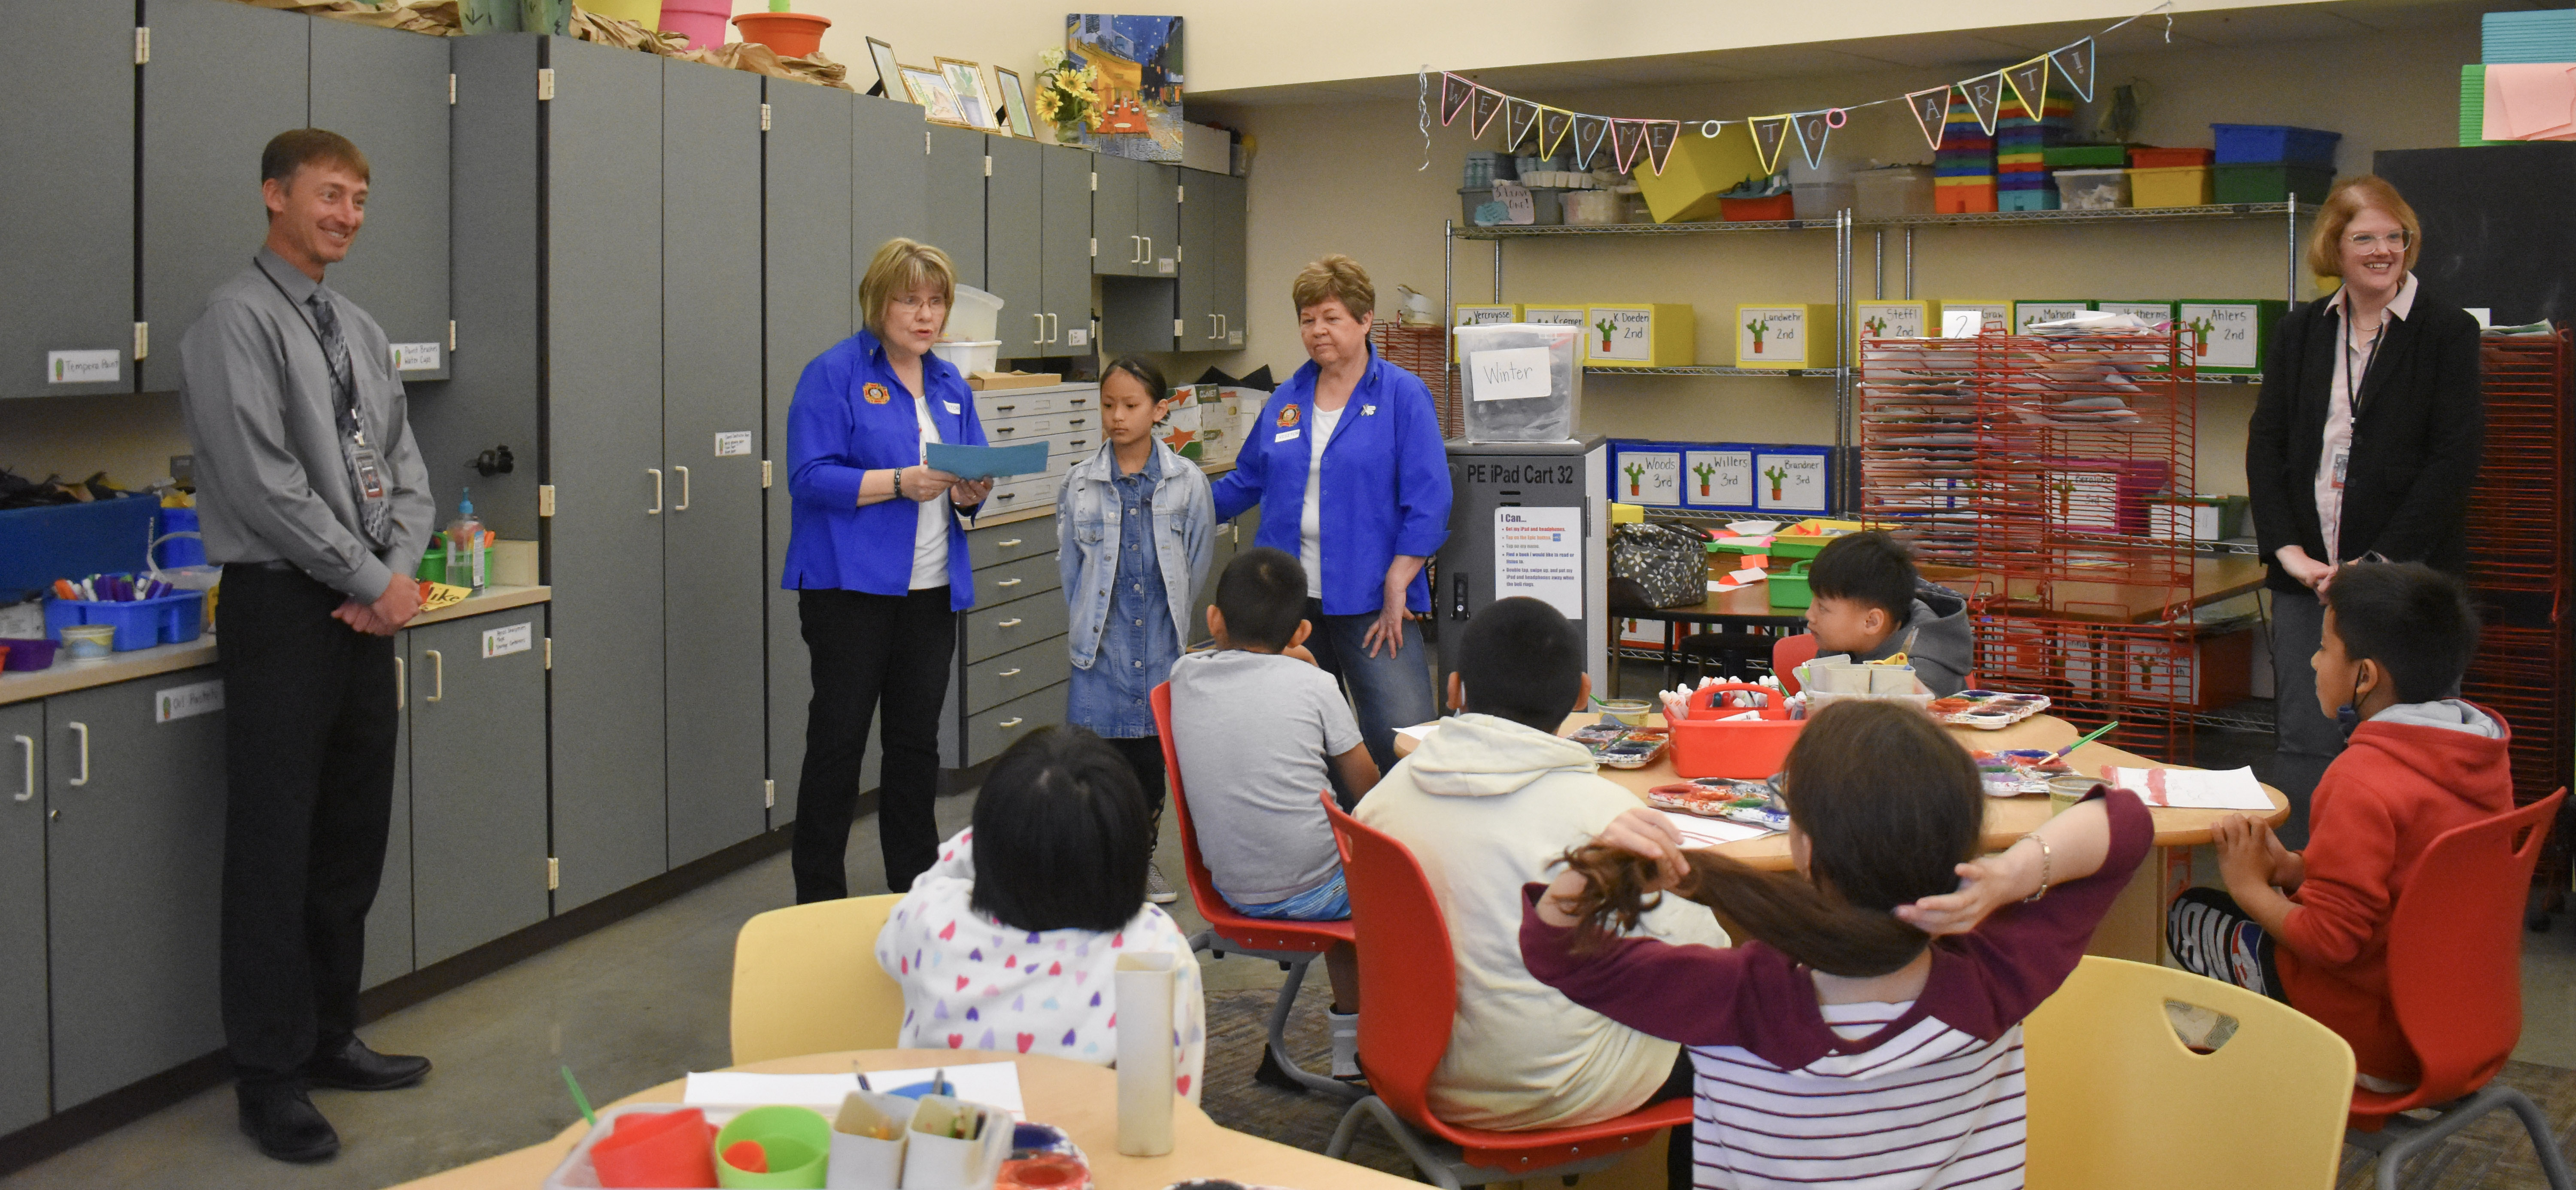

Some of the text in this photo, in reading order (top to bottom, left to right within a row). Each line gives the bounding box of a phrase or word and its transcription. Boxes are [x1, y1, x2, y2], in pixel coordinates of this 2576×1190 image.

[1448, 52, 2085, 148] WELCOME TO ART!
[1474, 311, 1510, 322] Vercruysse
[1614, 313, 1649, 322] K Doeden
[1764, 312, 1802, 321] Landwehr
[2211, 309, 2246, 321] Ahlers
[1624, 327, 1643, 338] 2nd
[1777, 328, 1794, 339] 2nd
[1896, 325, 1914, 337] 2nd
[2224, 328, 2244, 340] 2nd
[1483, 361, 1532, 385] Winter
[1646, 457, 1676, 470] Woods
[1714, 456, 1748, 468] Willers
[1785, 459, 1820, 470] Brandner
[1467, 464, 1574, 484] PE iPad Cart 32
[1720, 474, 1738, 486] 3rd
[1795, 475, 1810, 485] 3rd
[1653, 474, 1672, 487] 3rd
[1501, 513, 1527, 522] I Can...
